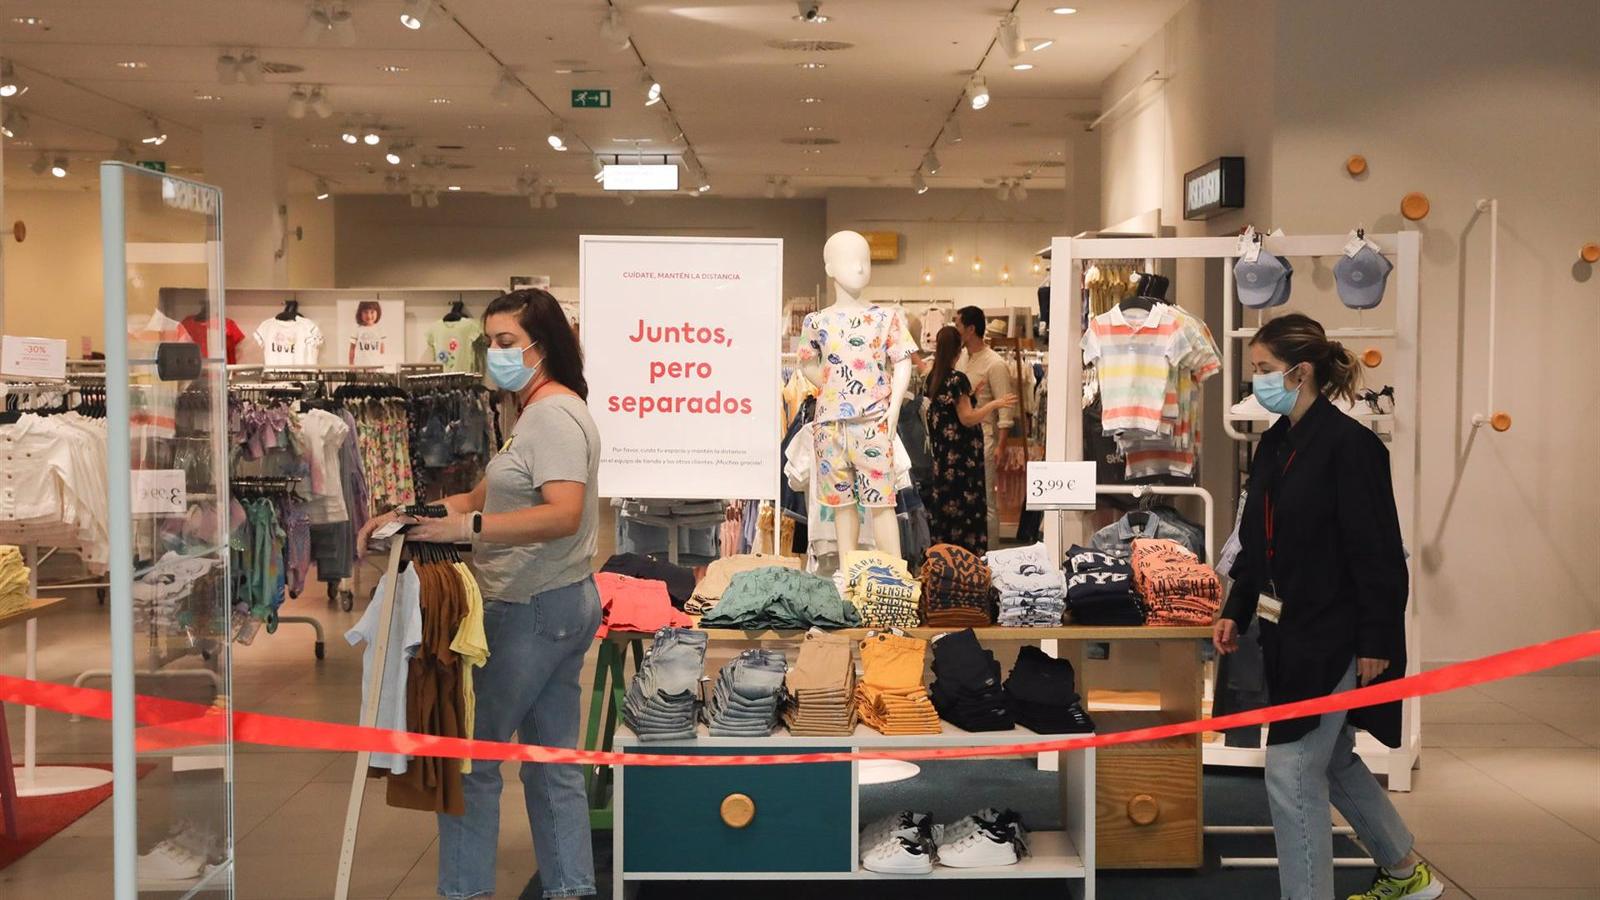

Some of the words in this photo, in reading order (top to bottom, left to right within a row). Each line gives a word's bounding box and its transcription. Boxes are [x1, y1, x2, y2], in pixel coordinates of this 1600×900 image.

[622, 271, 656, 280] CUÍDATE,
[657, 271, 690, 280] MANTÉN
[701, 273, 741, 281] DISTANCIA
[628, 318, 734, 348] Juntos,
[649, 360, 713, 384] pero
[607, 390, 753, 419] separados
